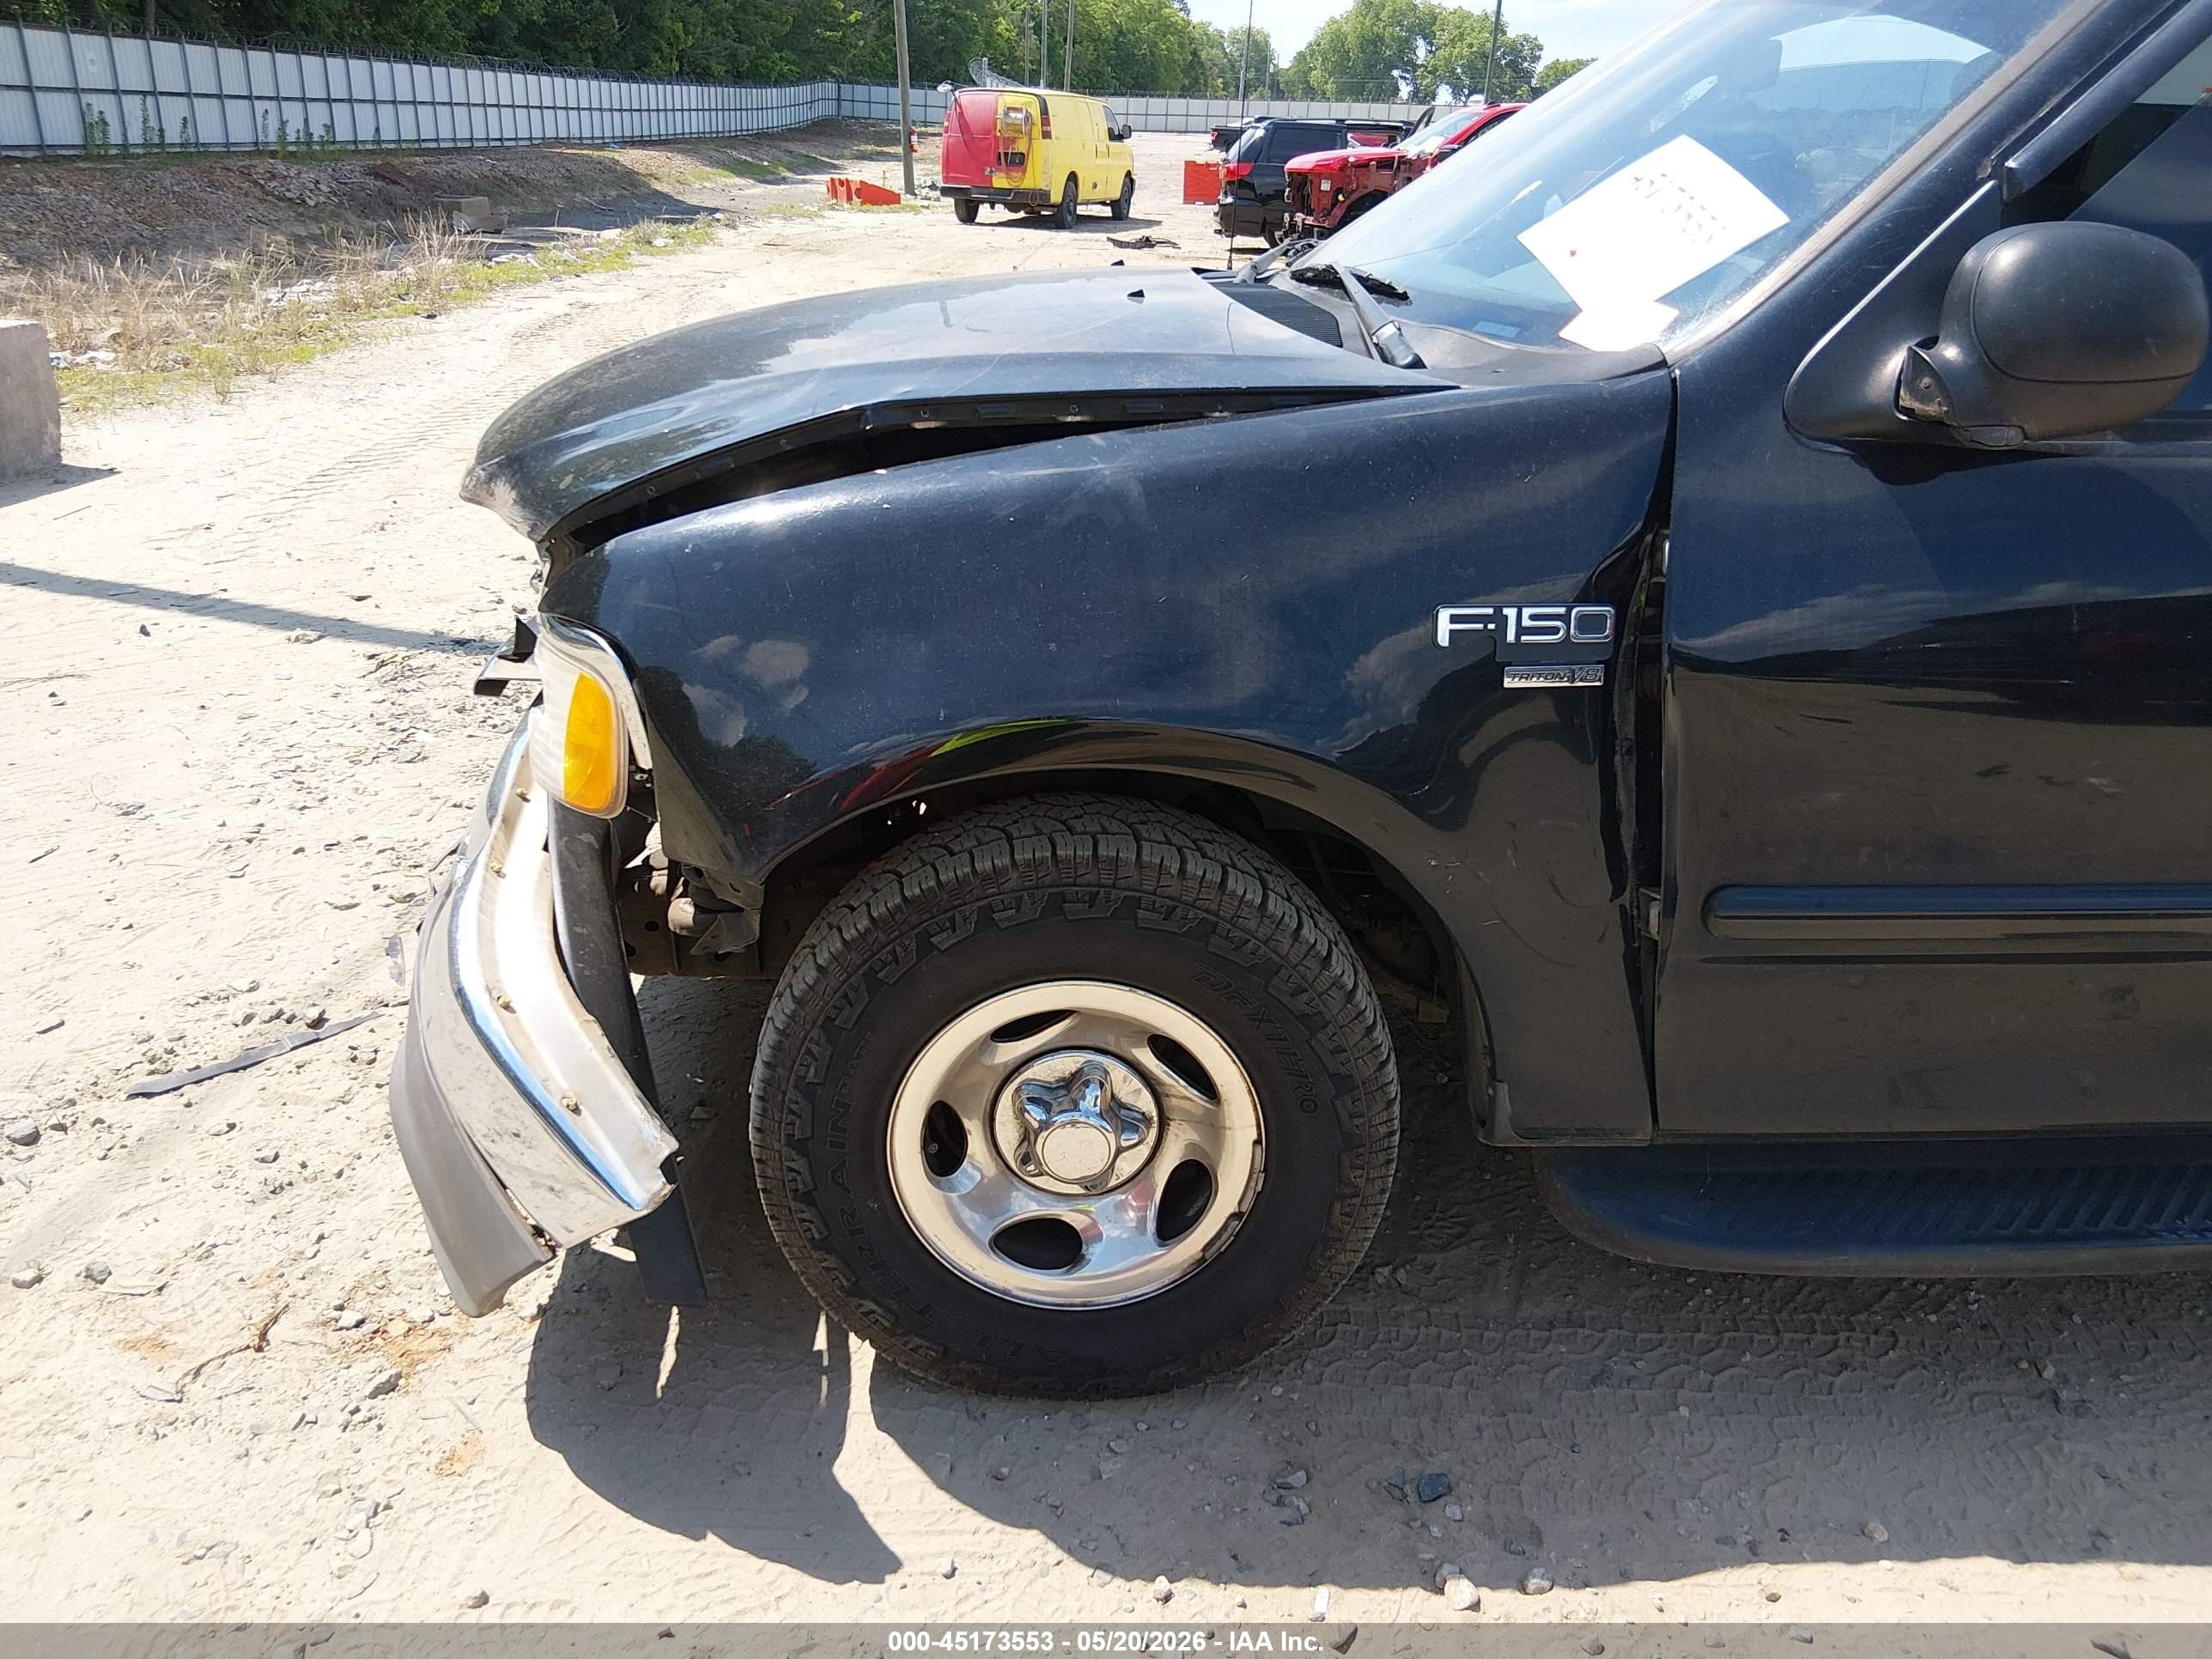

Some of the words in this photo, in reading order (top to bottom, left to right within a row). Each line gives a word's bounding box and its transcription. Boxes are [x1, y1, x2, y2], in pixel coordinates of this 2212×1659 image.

[1437, 606, 1615, 647] F-150
[1509, 672, 1568, 684] TRITON
[1567, 666, 1602, 684] V8
[1188, 961, 1320, 1115] DEXTERO
[823, 1095, 939, 1328] TERRAIN
